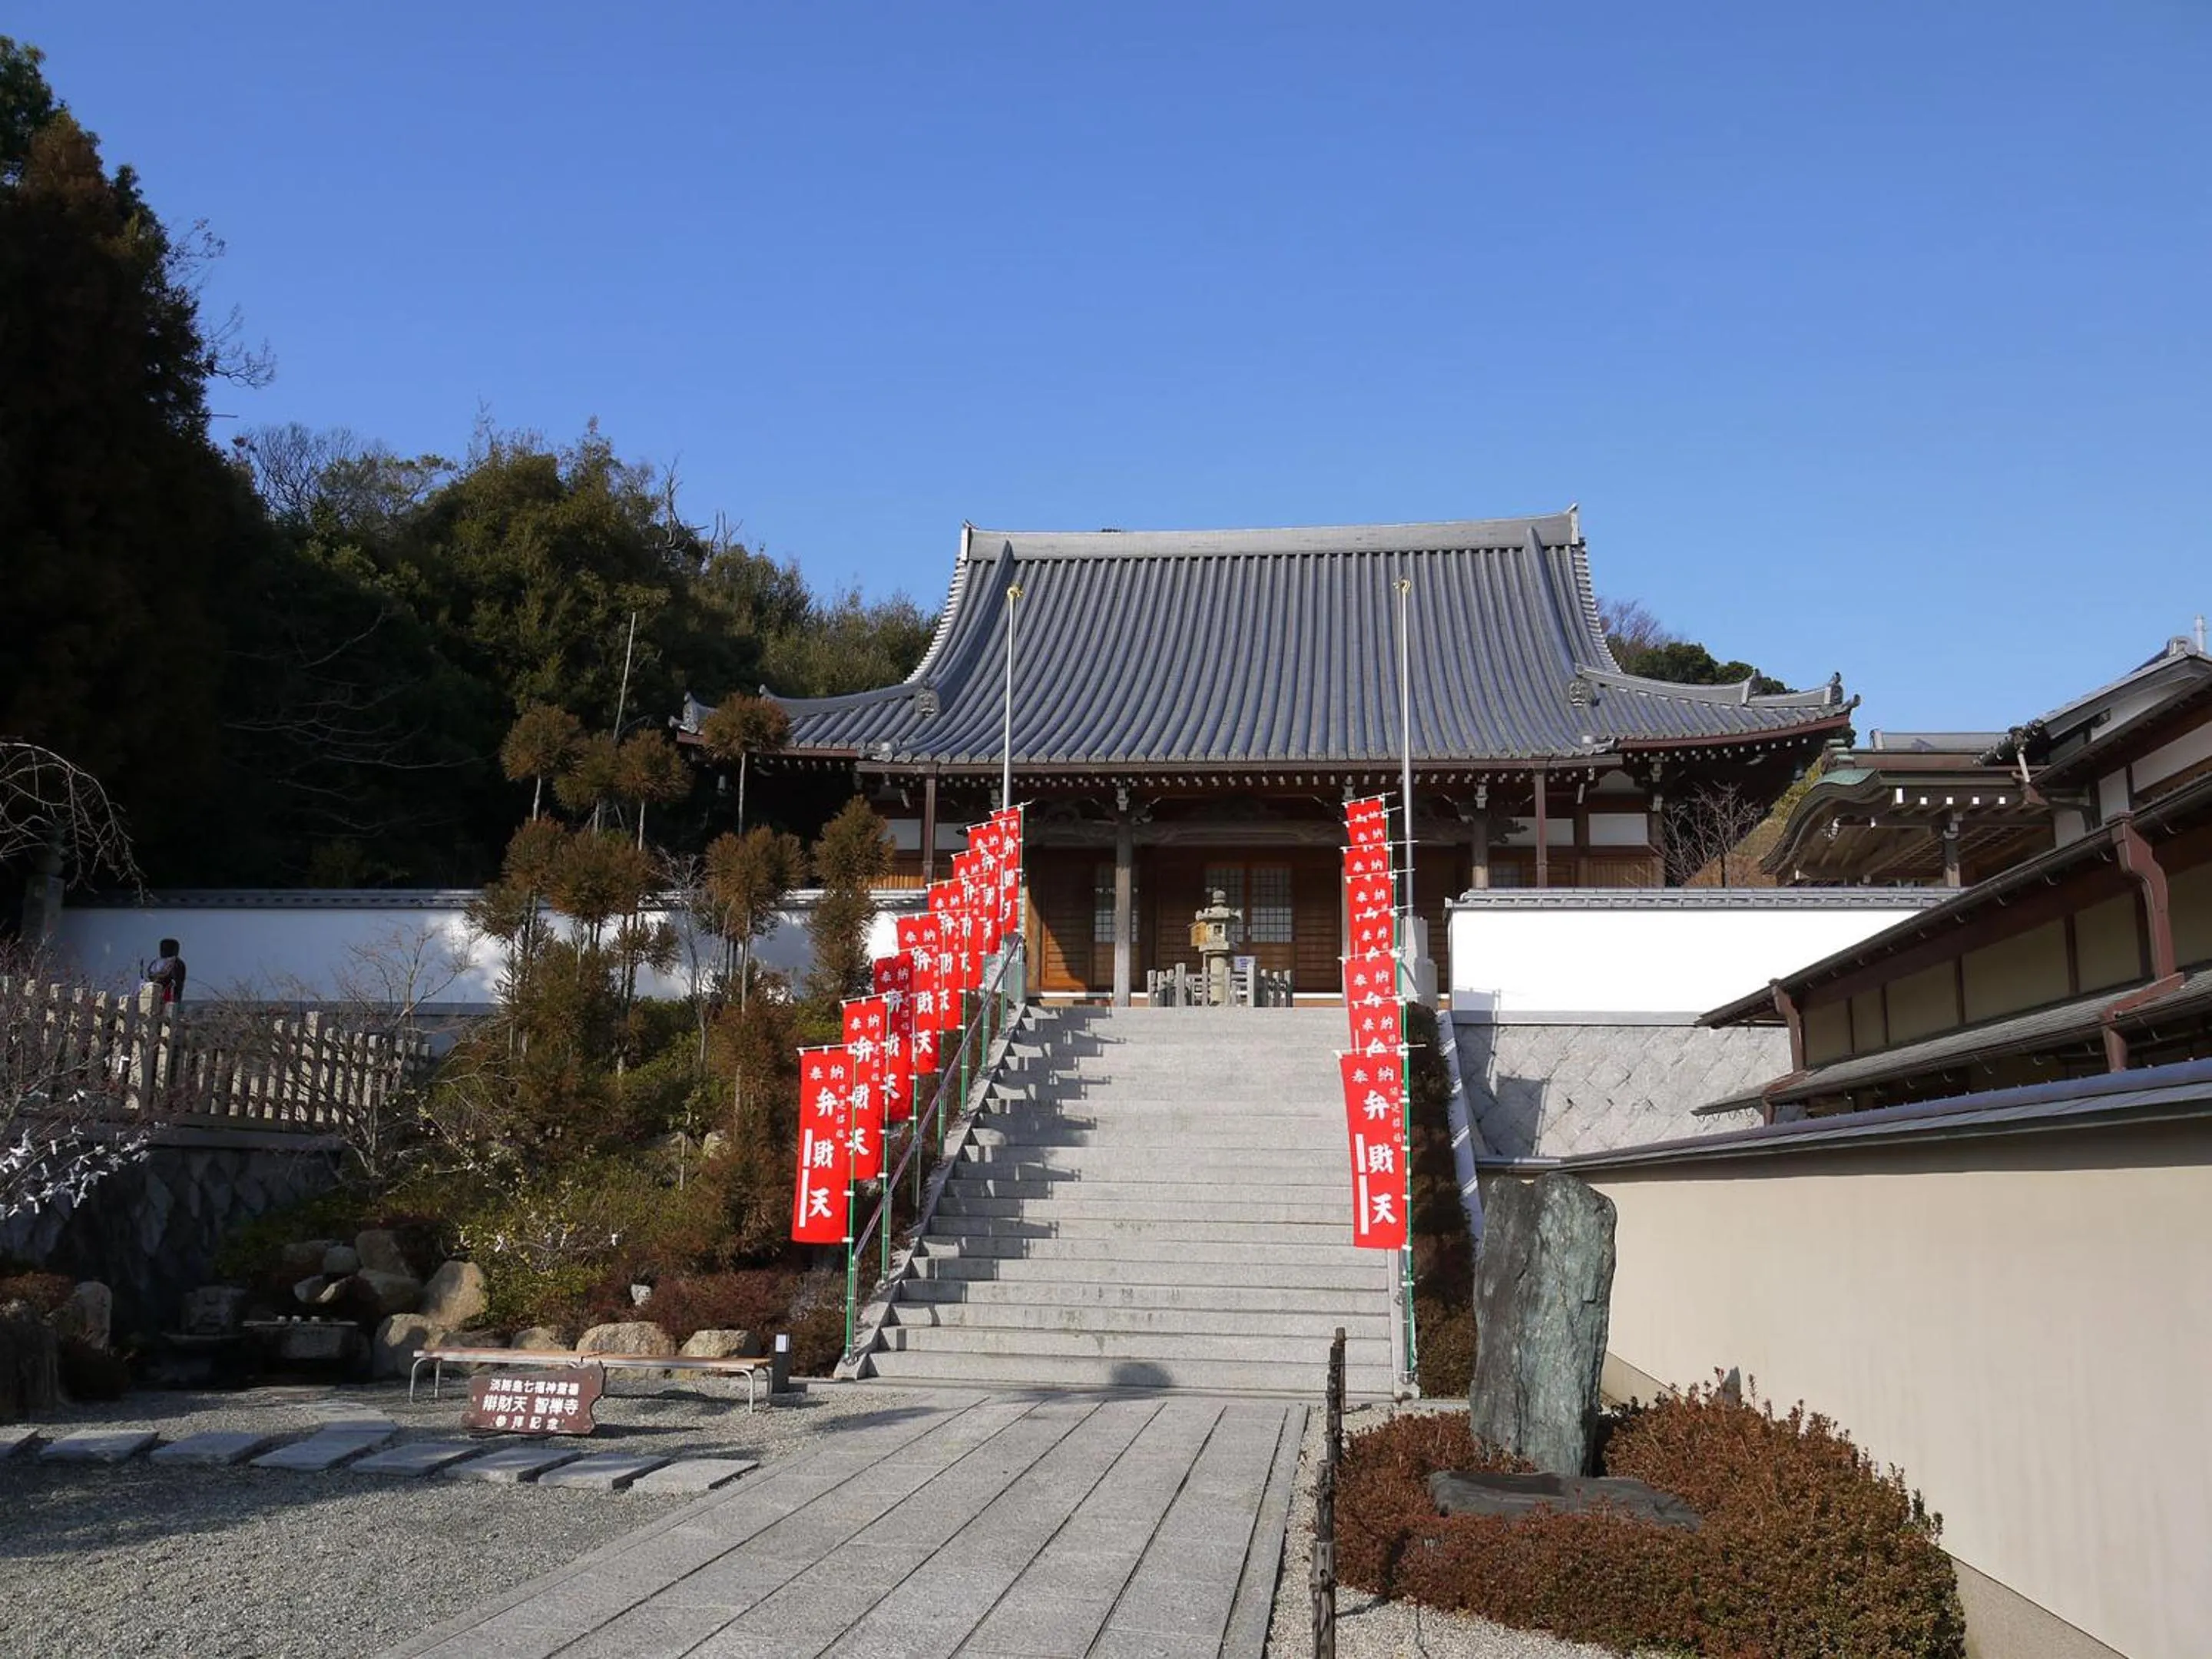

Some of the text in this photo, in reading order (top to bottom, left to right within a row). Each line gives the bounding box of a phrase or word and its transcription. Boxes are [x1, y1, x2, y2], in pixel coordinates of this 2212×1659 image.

[1353, 970, 1389, 987] 奉納
[1362, 1015, 1394, 1031] 奉納
[810, 1064, 844, 1081] 奉納
[1352, 1066, 1395, 1084] 奉納
[808, 1085, 838, 1218] 弁財天
[1363, 1089, 1398, 1225] 弁財天
